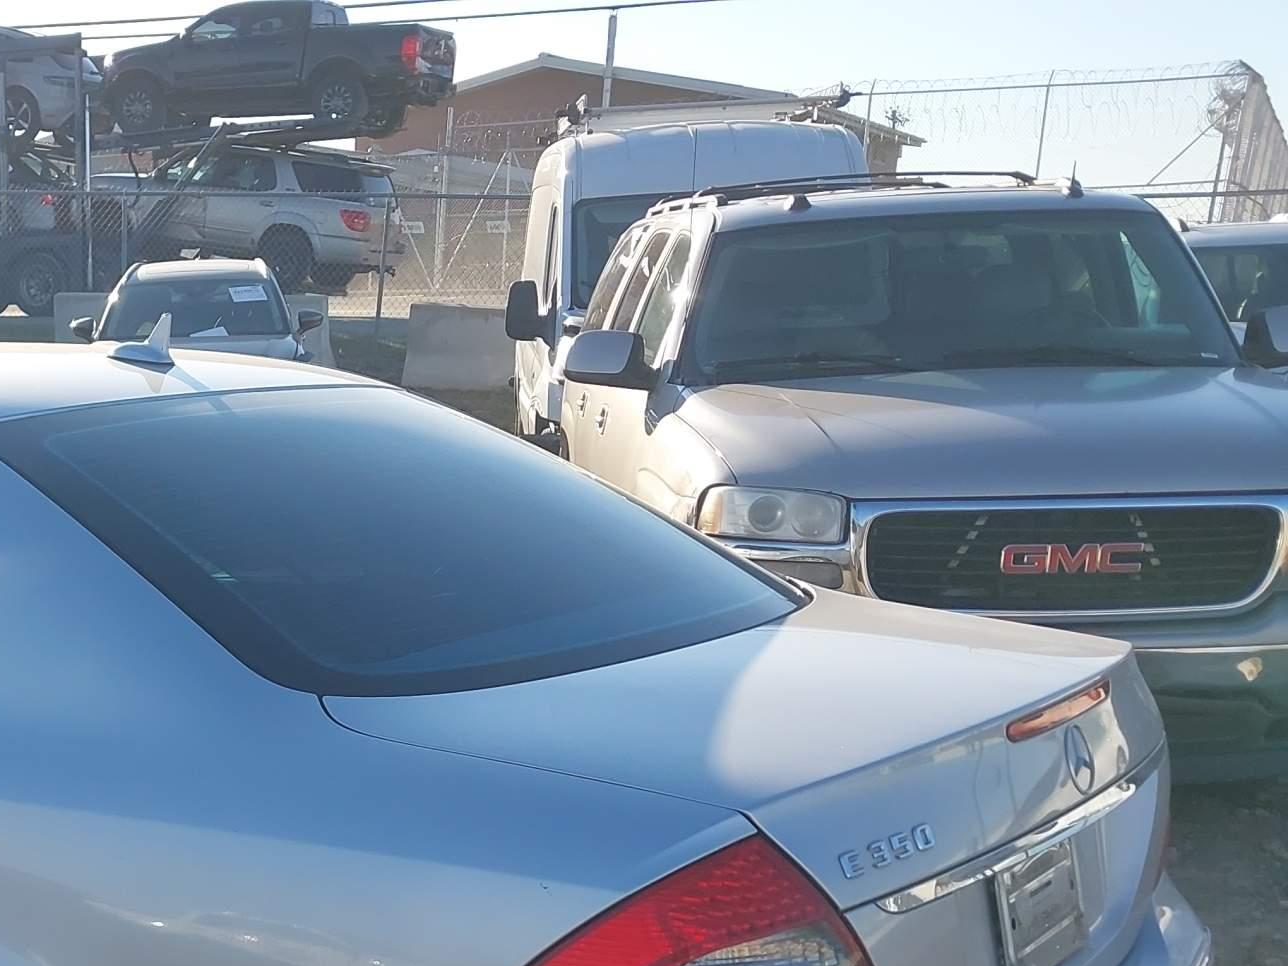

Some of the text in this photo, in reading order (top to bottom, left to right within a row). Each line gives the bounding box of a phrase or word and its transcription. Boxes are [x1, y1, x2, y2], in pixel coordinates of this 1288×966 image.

[1000, 542, 1144, 575] GMC
[838, 823, 935, 879] E 350
